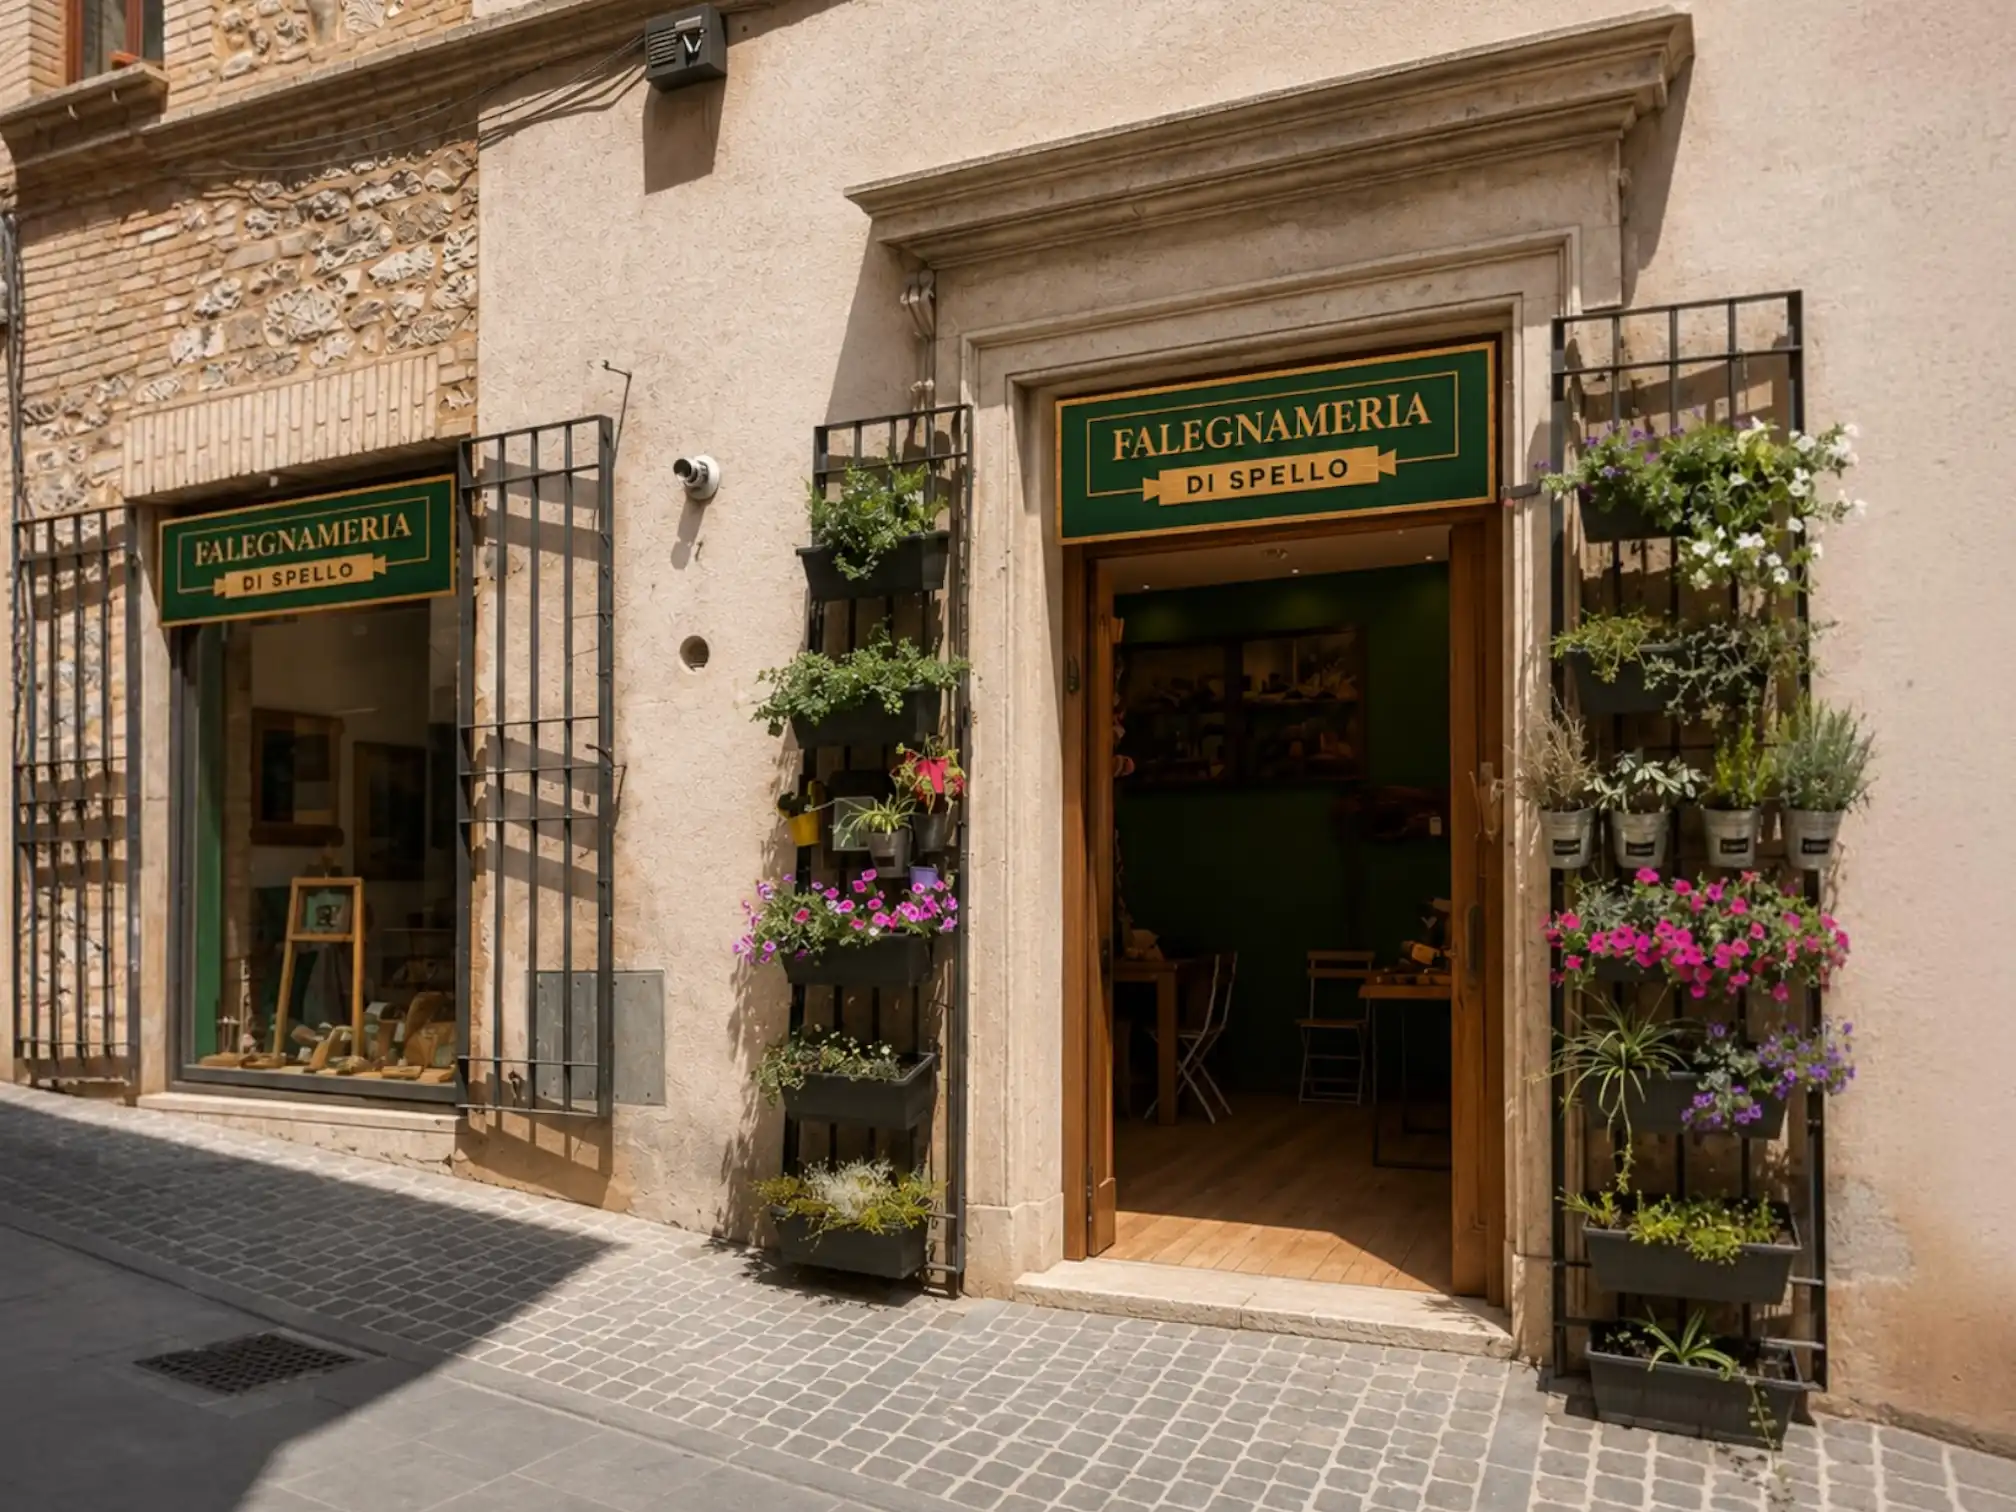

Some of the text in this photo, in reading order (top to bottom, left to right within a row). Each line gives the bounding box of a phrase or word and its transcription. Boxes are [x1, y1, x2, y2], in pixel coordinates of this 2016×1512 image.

[1113, 393, 1432, 461] FALEGNAMERIA
[1187, 459, 1348, 494] DI SPELLO
[196, 513, 412, 566] FALEGNAMERIA
[243, 563, 353, 591] DI SPELLO
